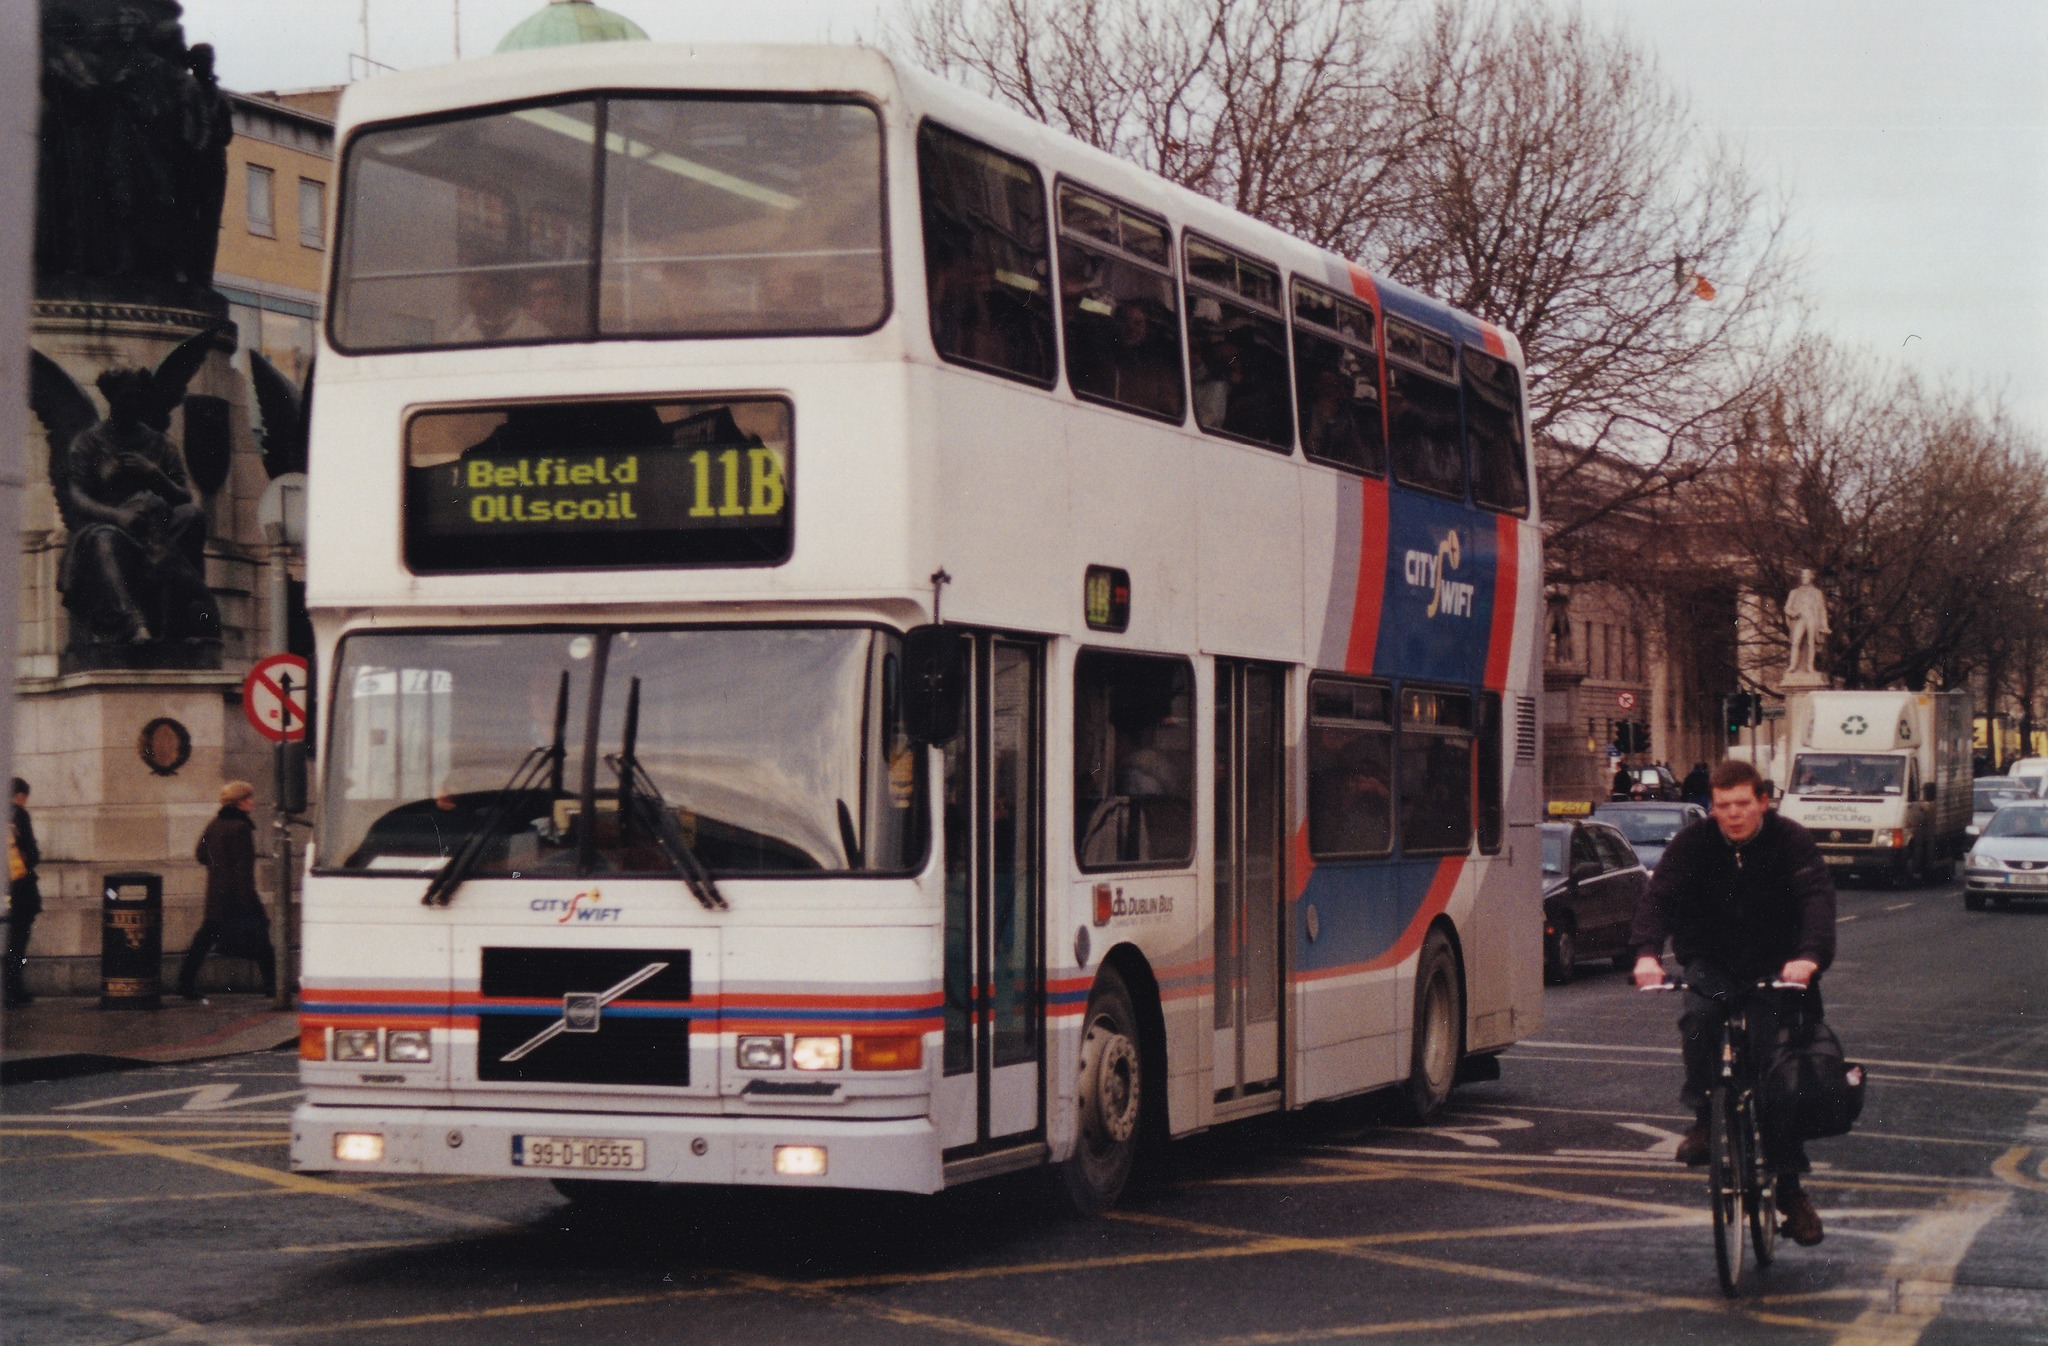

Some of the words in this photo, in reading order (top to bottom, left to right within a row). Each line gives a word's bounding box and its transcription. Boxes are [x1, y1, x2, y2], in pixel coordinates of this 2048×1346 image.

[468, 456, 638, 488] Belfield
[689, 449, 785, 517] 11B
[470, 492, 637, 522] Ollscoil
[1405, 549, 1438, 589] CITY
[1803, 813, 1872, 824] RECYCLING
[1816, 805, 1858, 813] FINGAL
[530, 899, 571, 912] CITY
[532, 1142, 633, 1167] 99-D-10555
